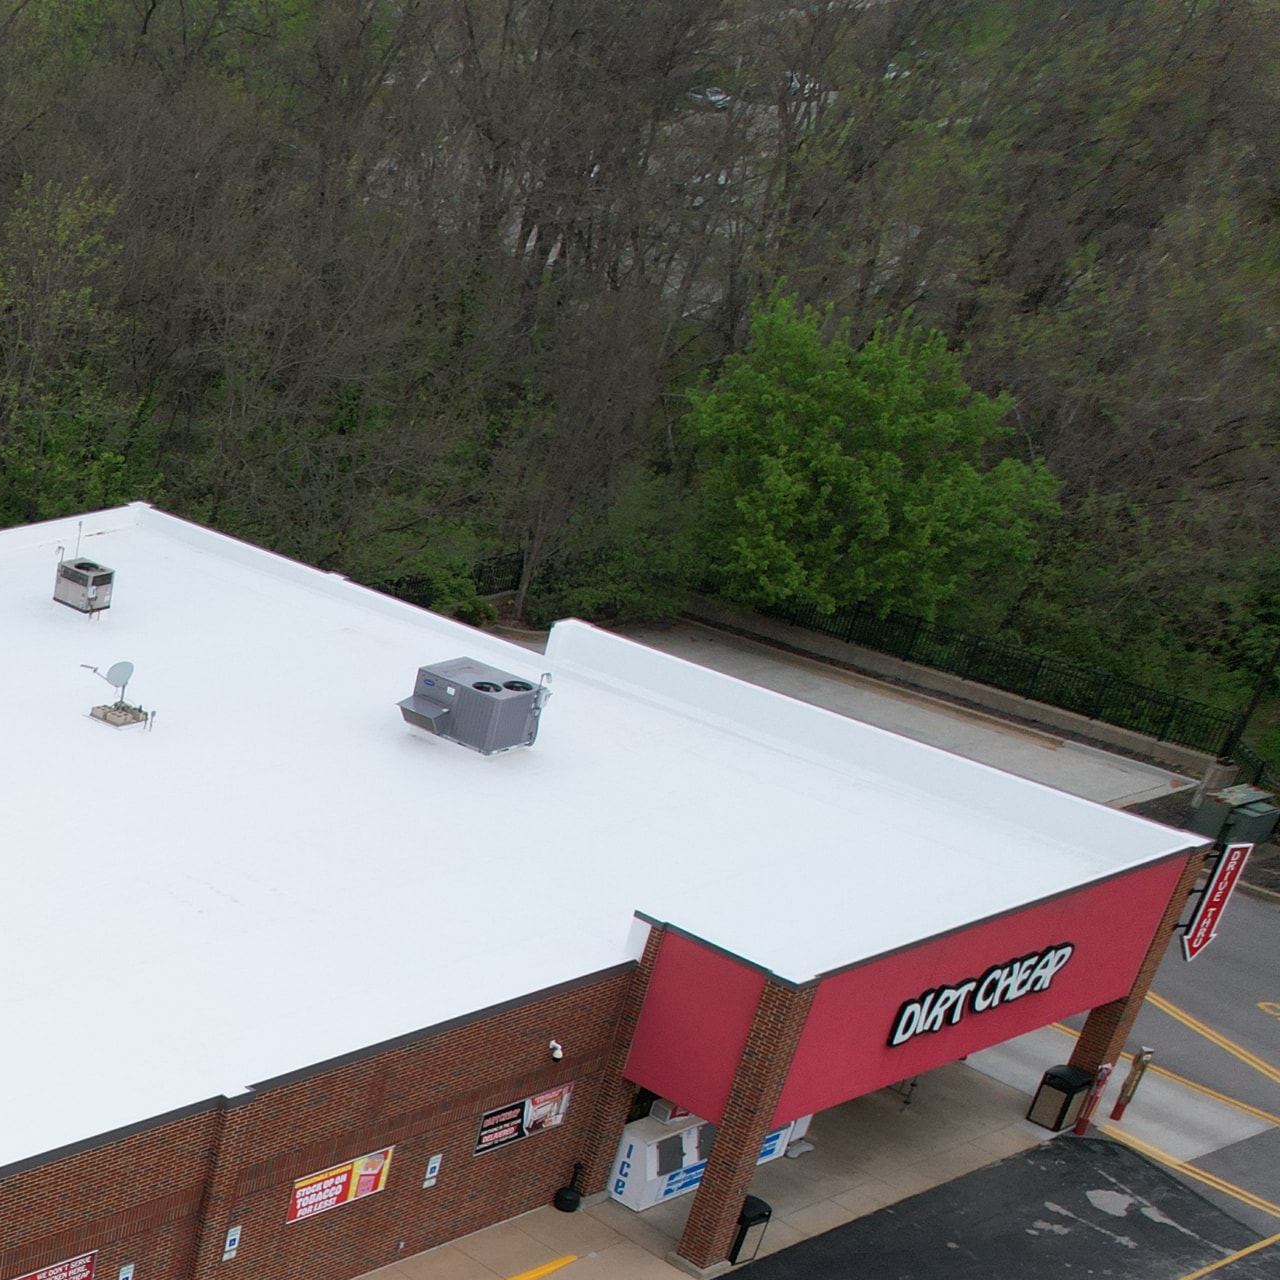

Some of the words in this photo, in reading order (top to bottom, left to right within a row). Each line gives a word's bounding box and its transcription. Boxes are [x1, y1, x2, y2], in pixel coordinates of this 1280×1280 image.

[1213, 850, 1241, 902] DRIVE
[1192, 907, 1217, 948] THRU
[892, 981, 977, 1045] DIRT
[975, 946, 1073, 1012] CHEAP
[295, 1182, 322, 1198] STOCK
[323, 1177, 335, 1189] UP
[335, 1173, 348, 1185] ON
[296, 1184, 343, 1209] TOBACCO
[296, 1205, 313, 1218] FOR
[313, 1196, 338, 1211] LESS!
[36, 1271, 47, 1280] WE
[48, 1263, 70, 1277] DON'T
[70, 1256, 92, 1269] SERVE
